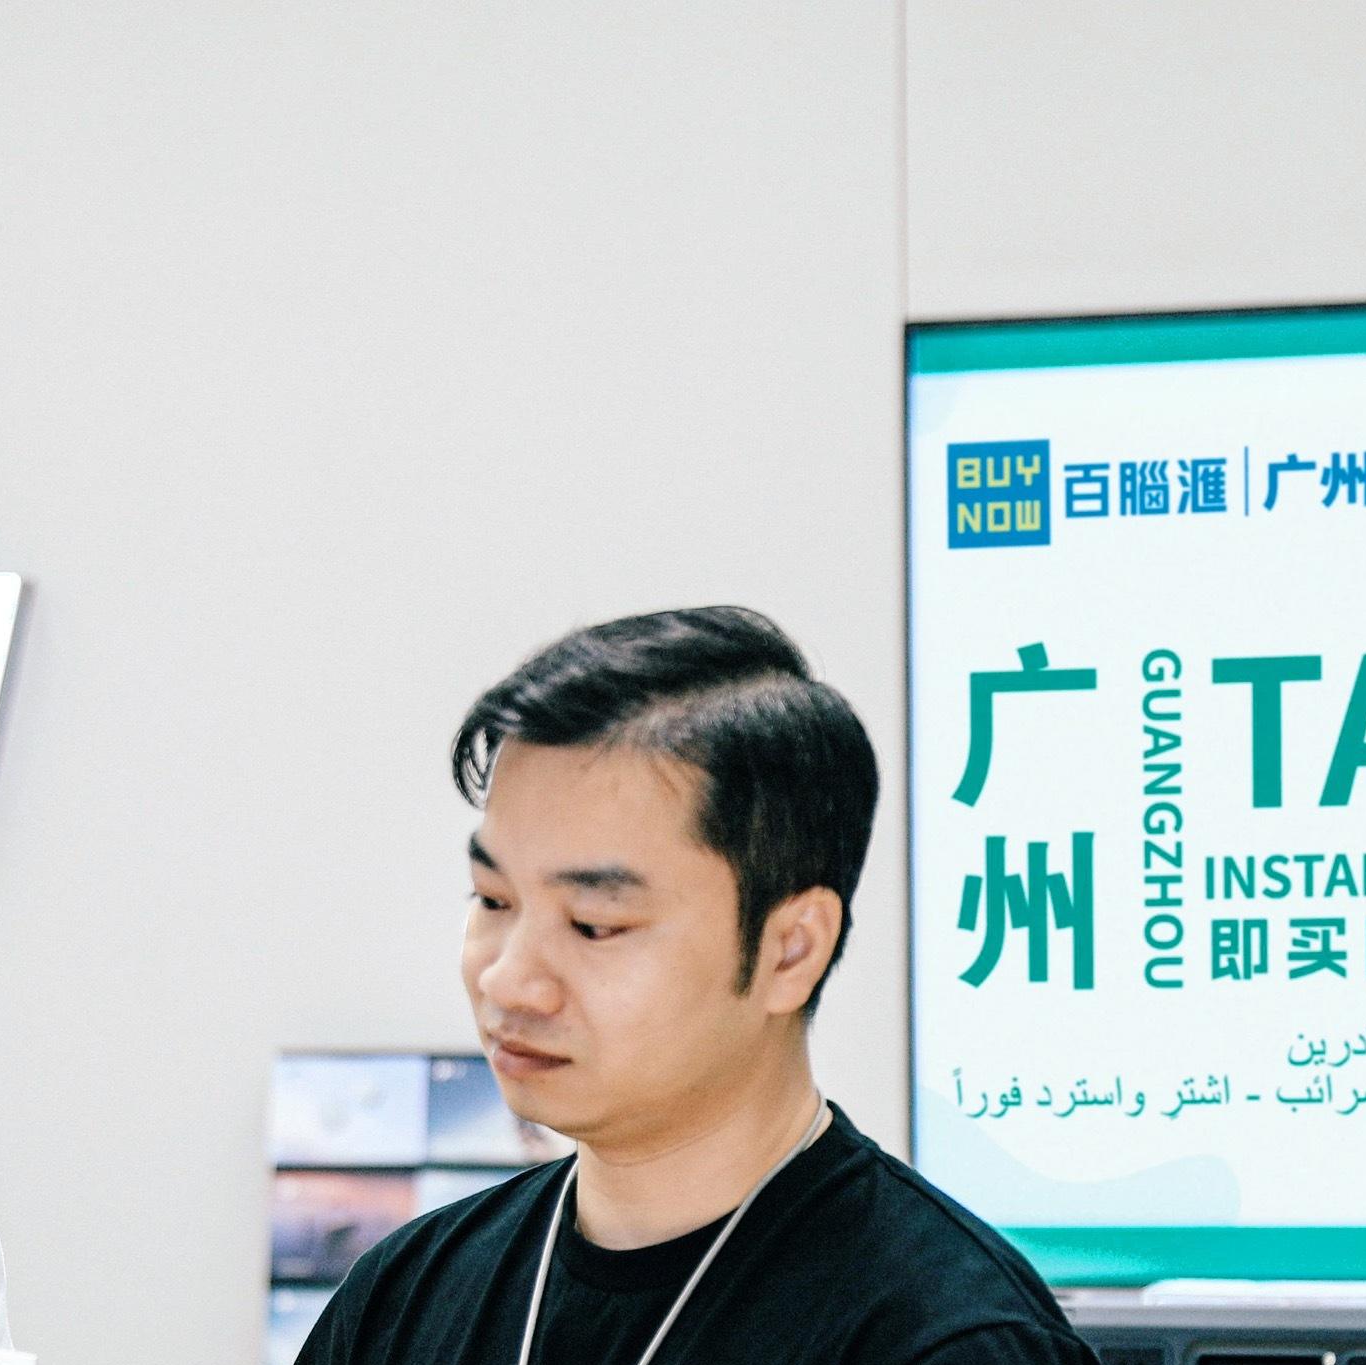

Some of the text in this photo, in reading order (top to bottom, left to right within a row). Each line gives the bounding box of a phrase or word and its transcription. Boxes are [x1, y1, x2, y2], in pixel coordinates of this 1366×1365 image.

[957, 454, 1041, 490] BUY
[957, 501, 1041, 535] NOW
[951, 641, 1098, 991] 广州
[1141, 648, 1185, 989] GUANGZHOU
